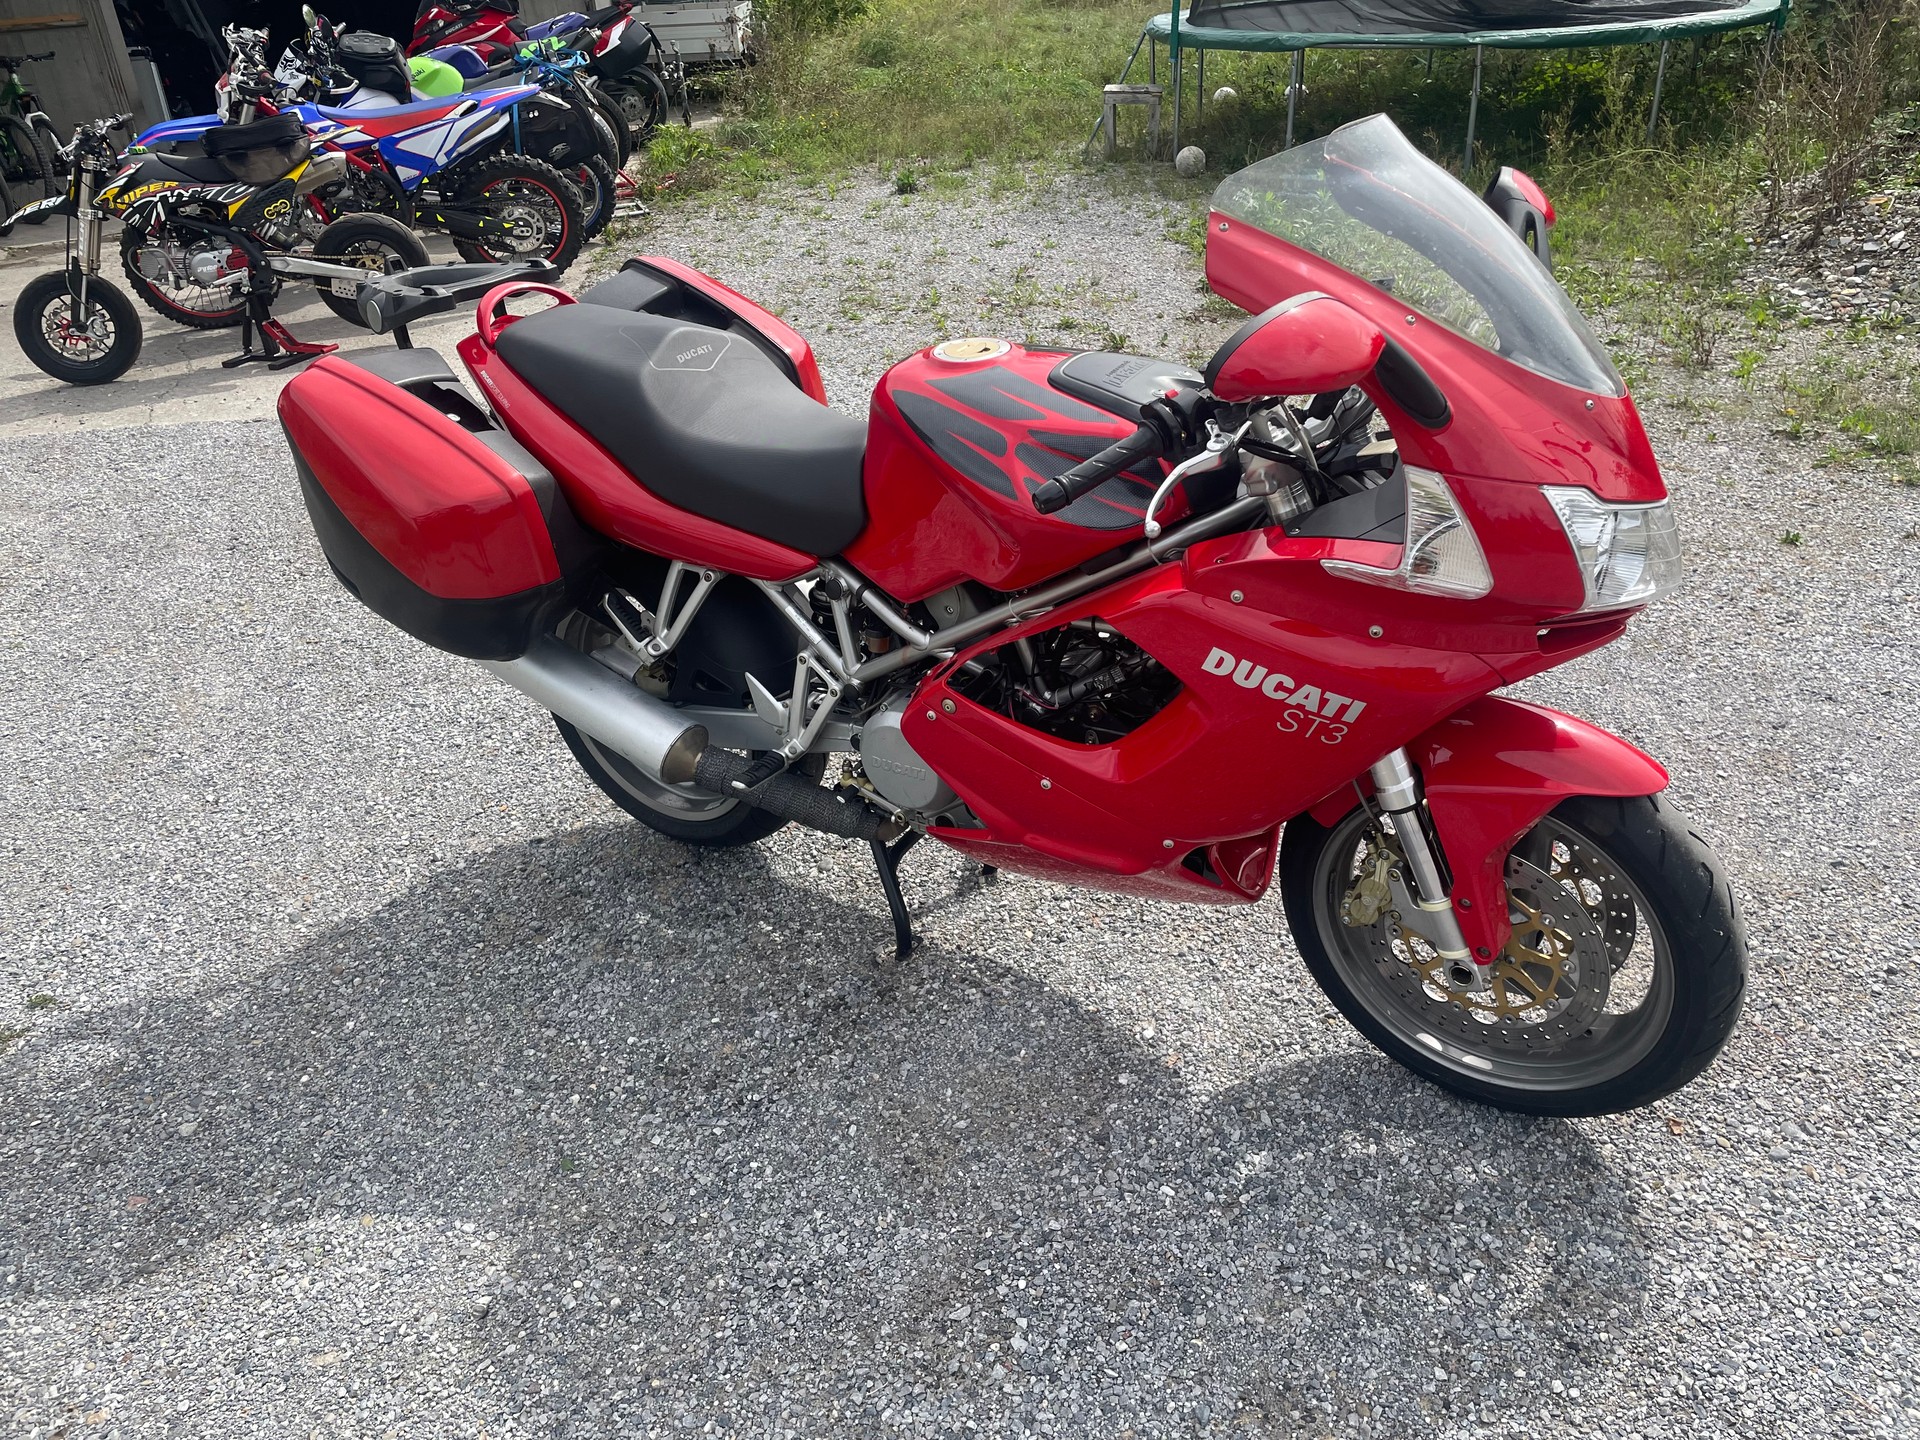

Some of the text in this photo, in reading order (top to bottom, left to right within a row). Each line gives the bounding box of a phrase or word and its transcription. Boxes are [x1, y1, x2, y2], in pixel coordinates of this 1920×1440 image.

[444, 22, 464, 36] DUCATI
[676, 344, 713, 364] DUCATI
[1201, 646, 1367, 723] DUCATI
[1276, 709, 1349, 744] ST3
[871, 755, 927, 781] DUCATI
